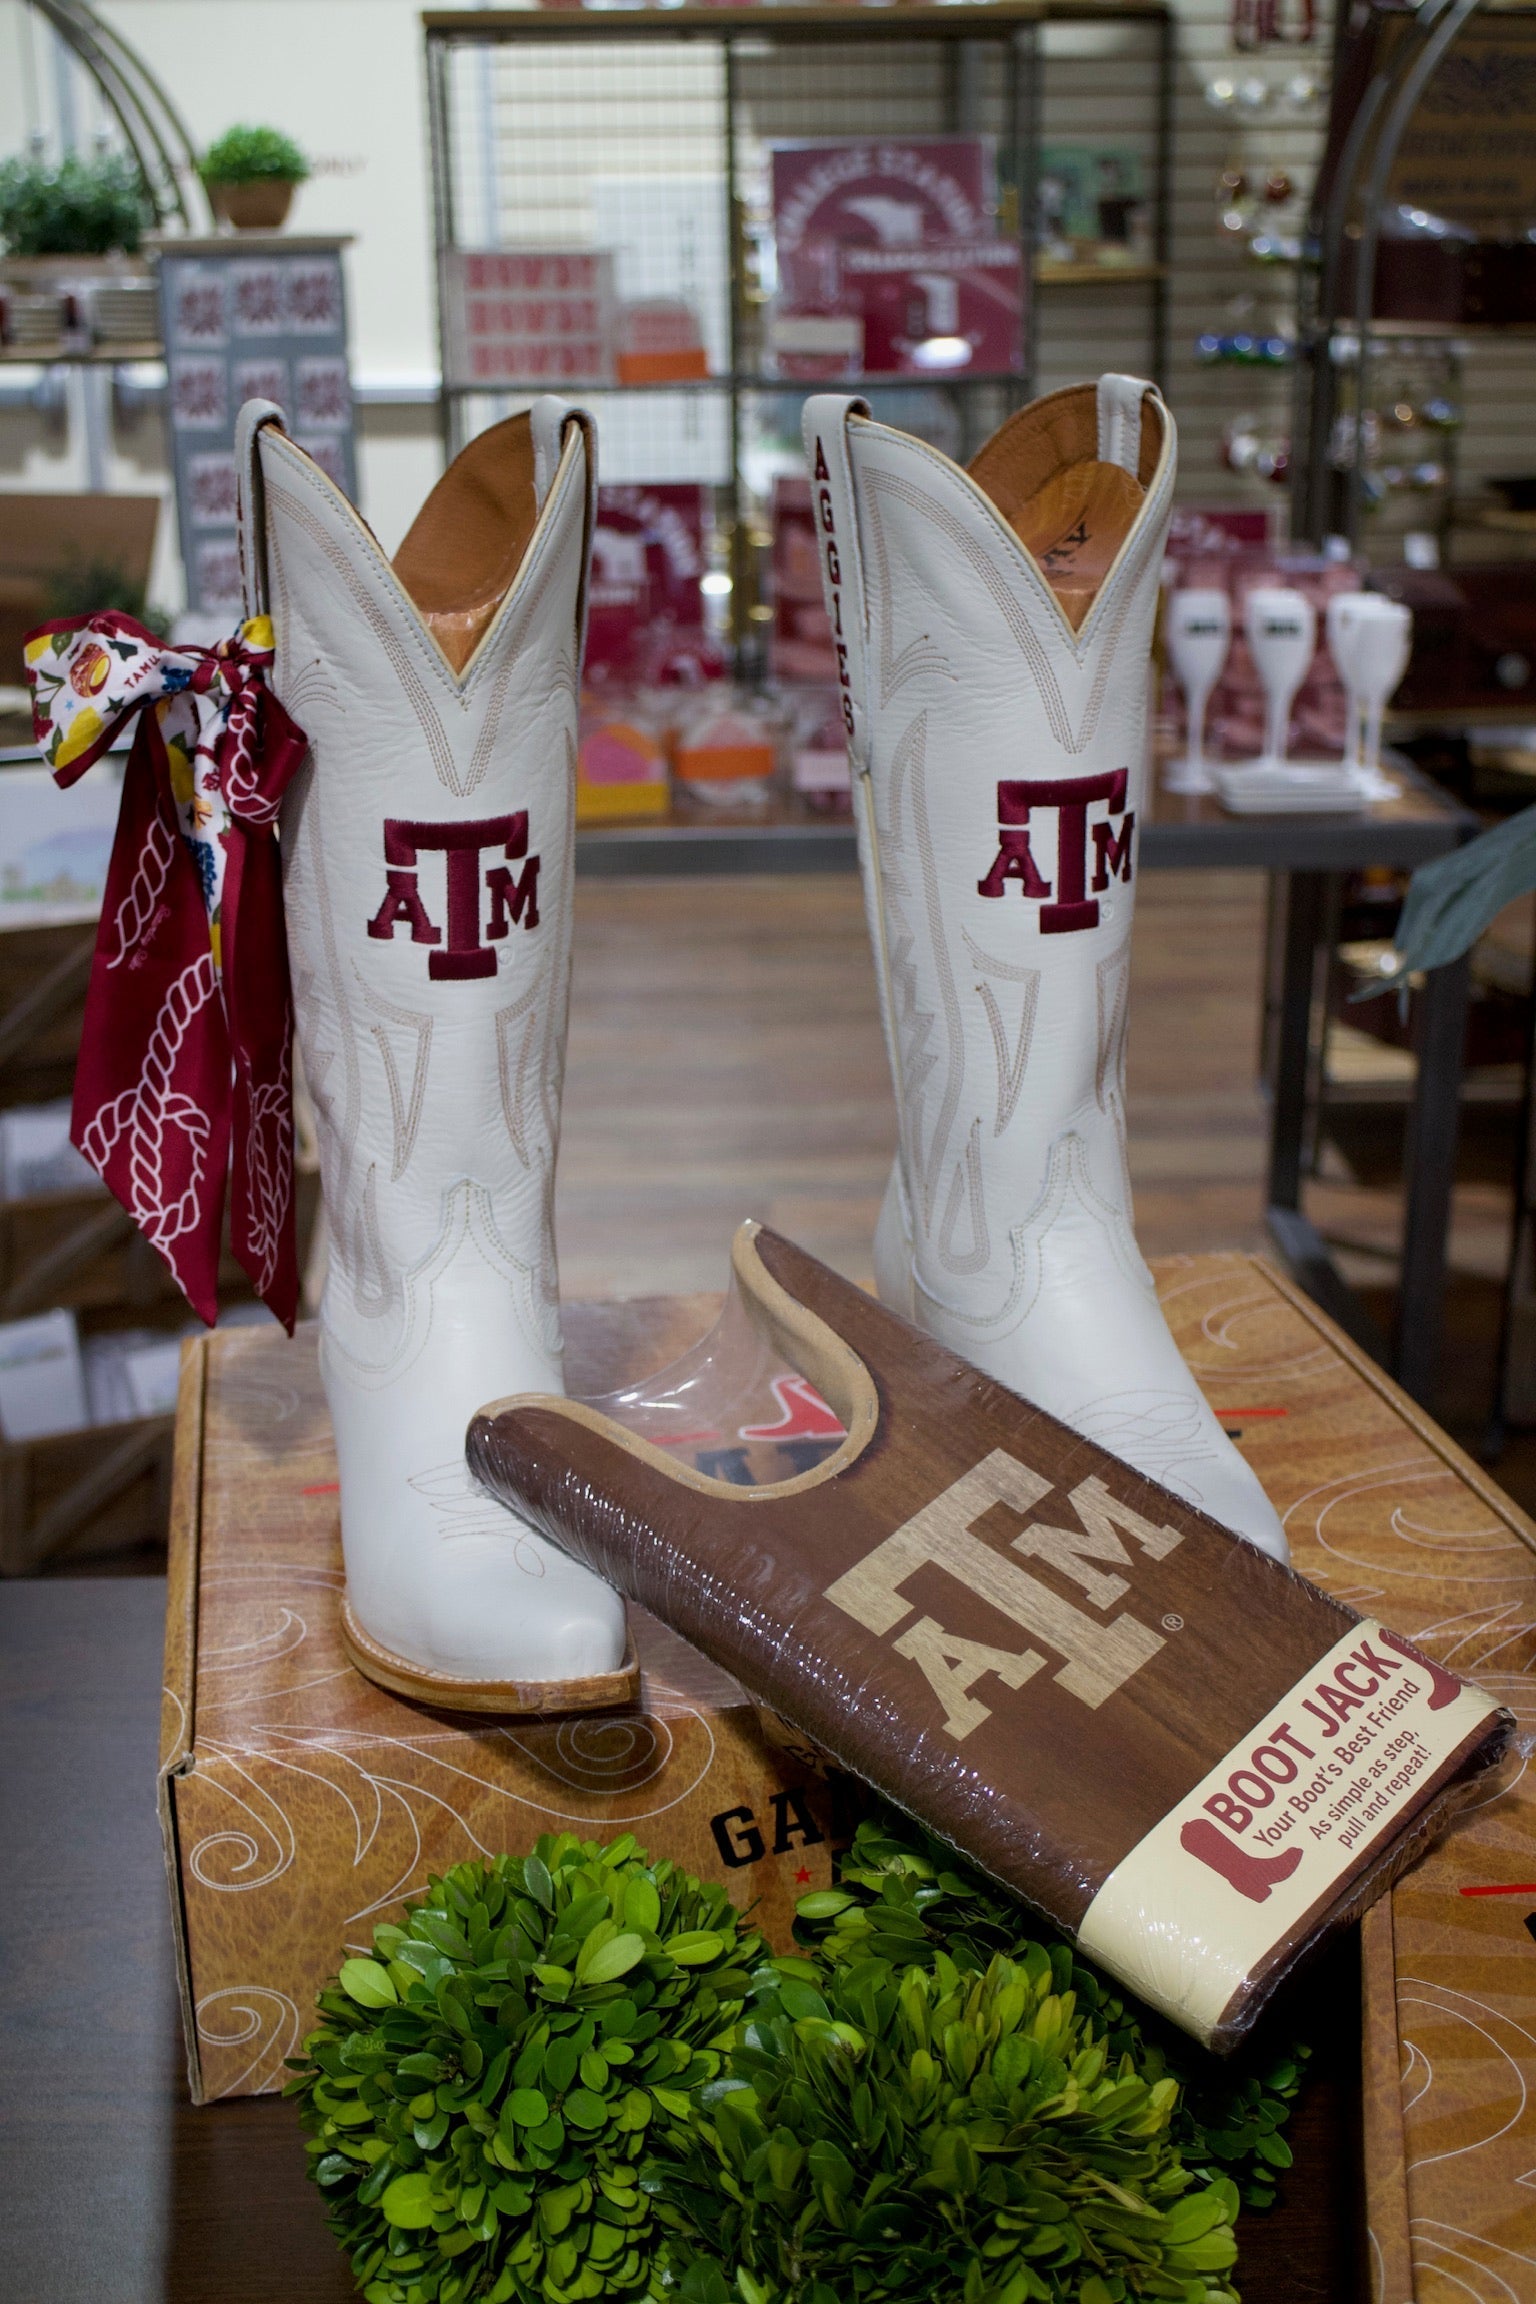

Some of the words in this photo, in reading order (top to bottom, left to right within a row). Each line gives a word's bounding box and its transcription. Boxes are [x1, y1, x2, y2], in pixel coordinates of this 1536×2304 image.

[815, 435, 855, 736] AGGIES
[124, 655, 161, 688] TAMU
[1202, 1722, 1316, 1834] BOOT
[1301, 1640, 1402, 1738] JACK
[1253, 1810, 1297, 1847] Your
[1288, 1762, 1343, 1813] Boot's
[1333, 1725, 1377, 1765] Best
[1367, 1678, 1420, 1729] Friend
[1308, 1819, 1332, 1840] As
[1328, 1776, 1373, 1821] simple
[1368, 1758, 1388, 1778] as
[1387, 1728, 1420, 1762] step,
[1338, 1816, 1367, 1849] pull
[1362, 1793, 1389, 1822] and
[1386, 1745, 1432, 1797] repeat!
